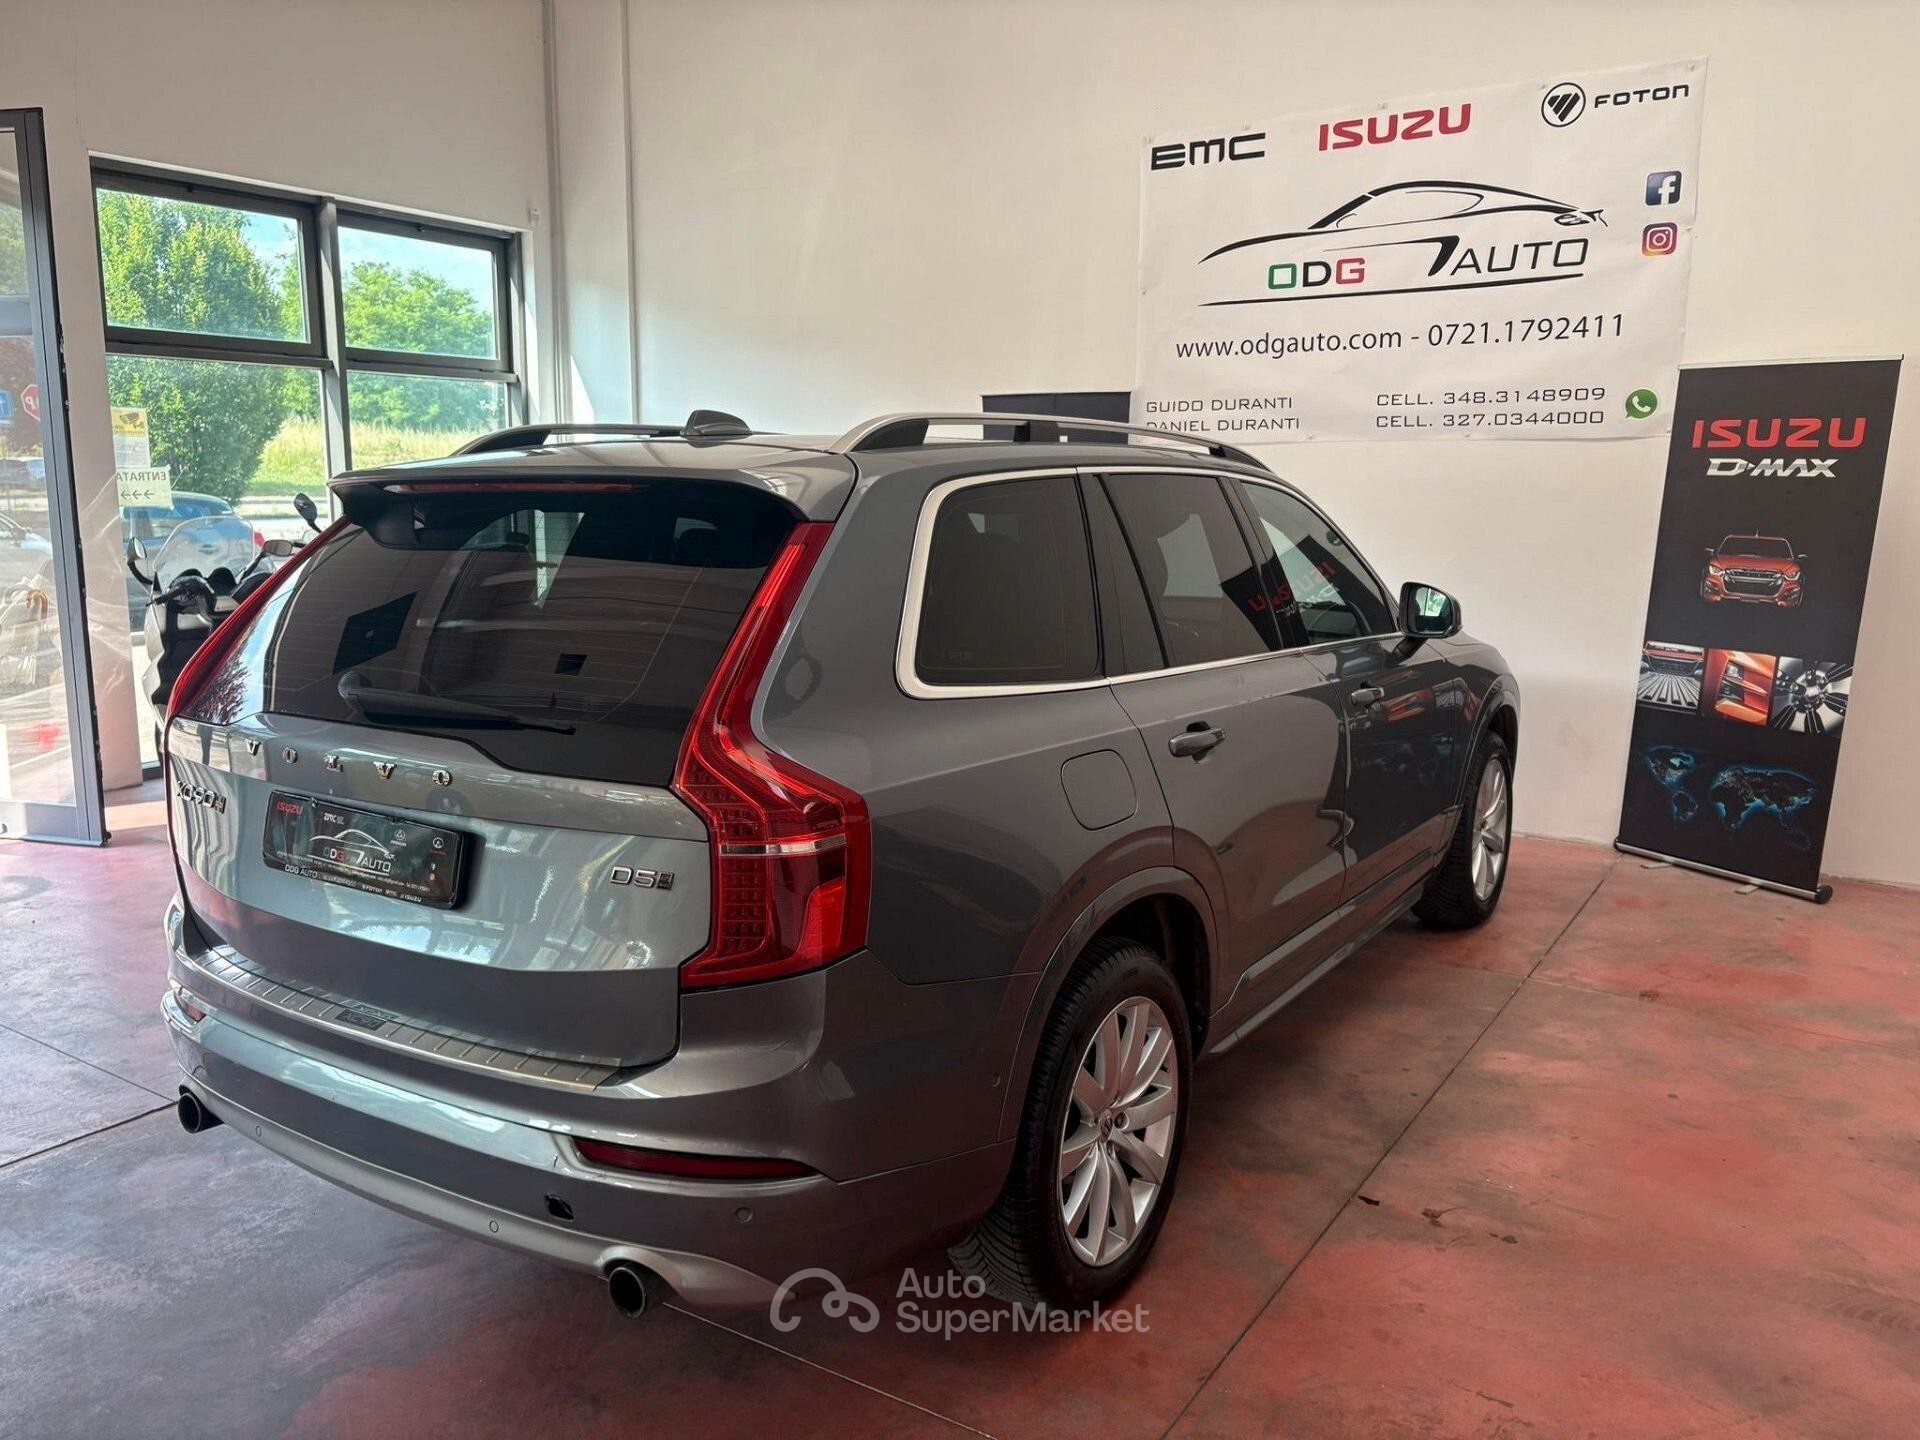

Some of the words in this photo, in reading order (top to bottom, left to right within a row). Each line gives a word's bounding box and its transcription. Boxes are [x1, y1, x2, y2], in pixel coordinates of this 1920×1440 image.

[1594, 84, 1689, 109] FOTON
[1319, 103, 1471, 151] ISUZU
[1151, 132, 1266, 170] EMC
[1268, 257, 1366, 290] ODG
[1450, 238, 1588, 276] AUTO
[1176, 331, 1402, 359] www.odgauto.com
[1428, 313, 1623, 346] 0721.1792411
[1146, 400, 1204, 413] GUIDO
[1211, 397, 1292, 411] DURANTI
[1376, 393, 1433, 406] CELL.
[1443, 387, 1606, 404] 348.3148909
[1217, 418, 1300, 431] DURANTI
[1376, 414, 1433, 428] CELL.
[1443, 411, 1604, 427] 327.0344000
[1692, 417, 1867, 448] ISUZU
[246, 739, 453, 787] VOLVO
[277, 800, 304, 815] ISUZU
[610, 866, 657, 888] D5
